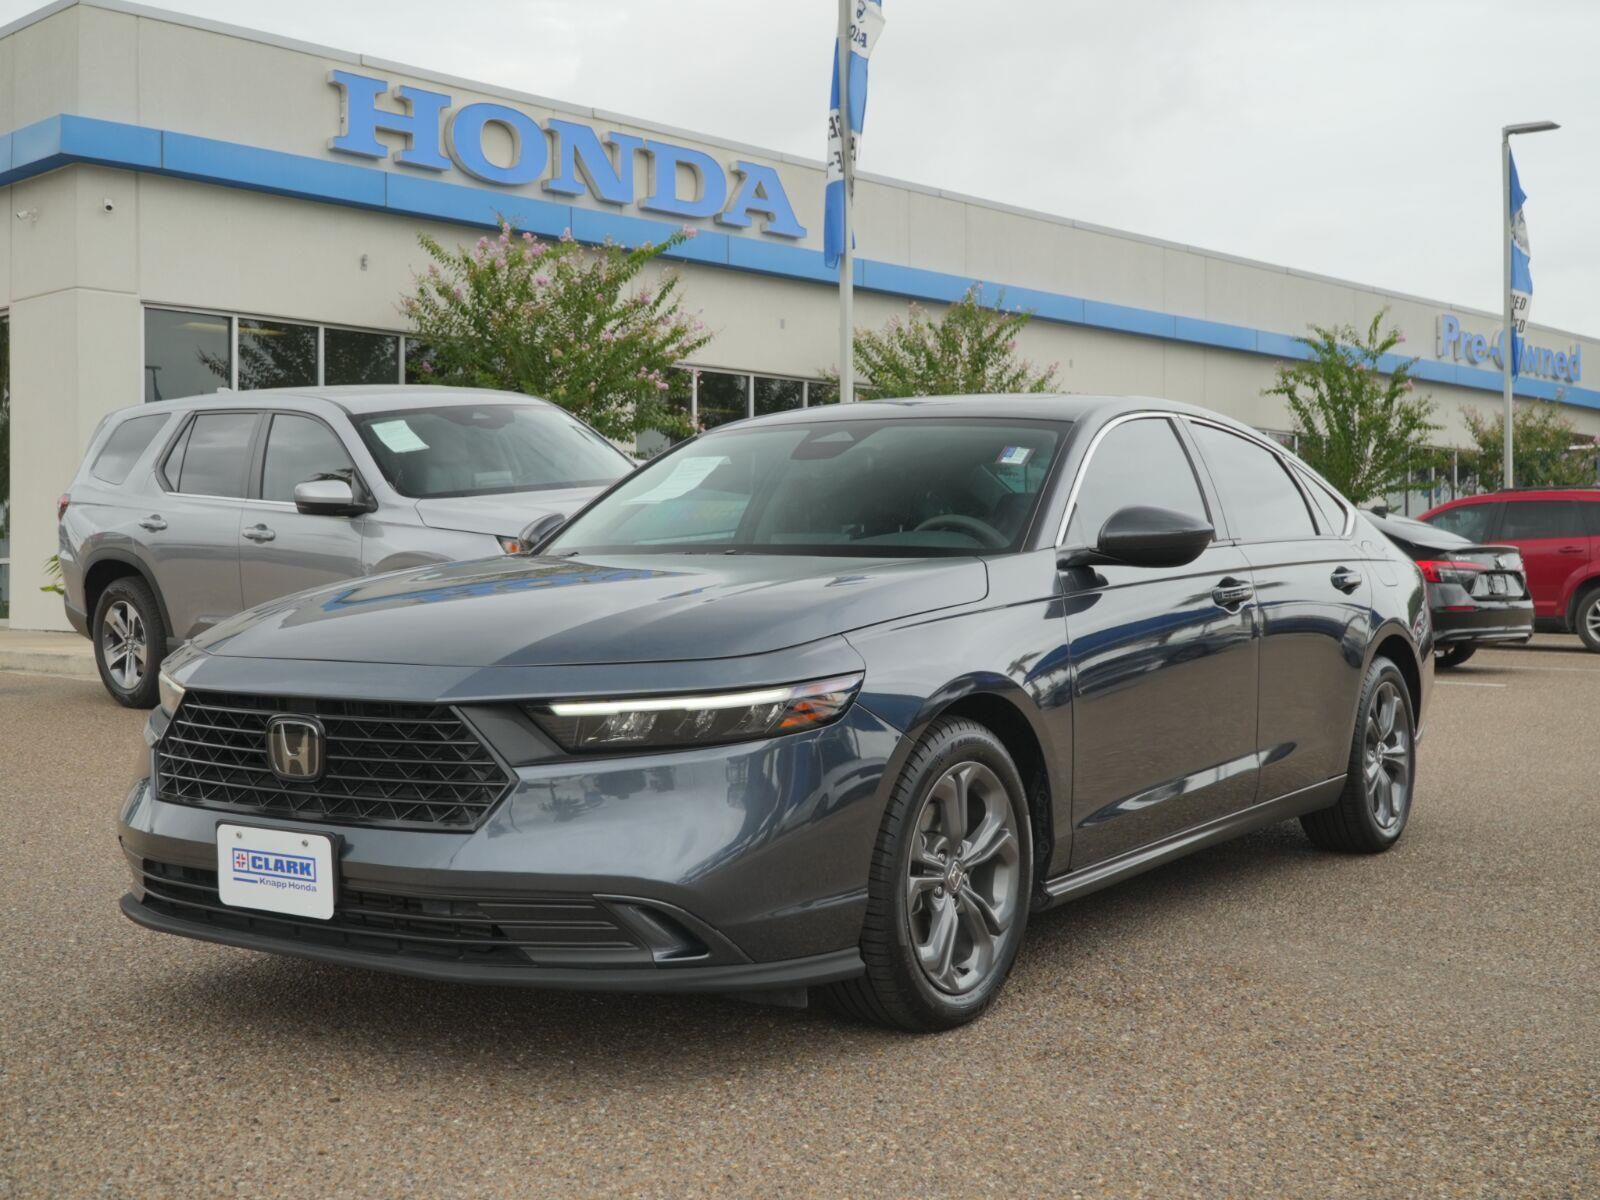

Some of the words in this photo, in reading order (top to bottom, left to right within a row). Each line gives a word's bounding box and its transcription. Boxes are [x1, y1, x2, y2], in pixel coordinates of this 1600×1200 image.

[328, 69, 807, 239] HONDA
[251, 855, 312, 877] CLARK
[259, 877, 287, 889] Knapp
[288, 881, 317, 893] Honda
